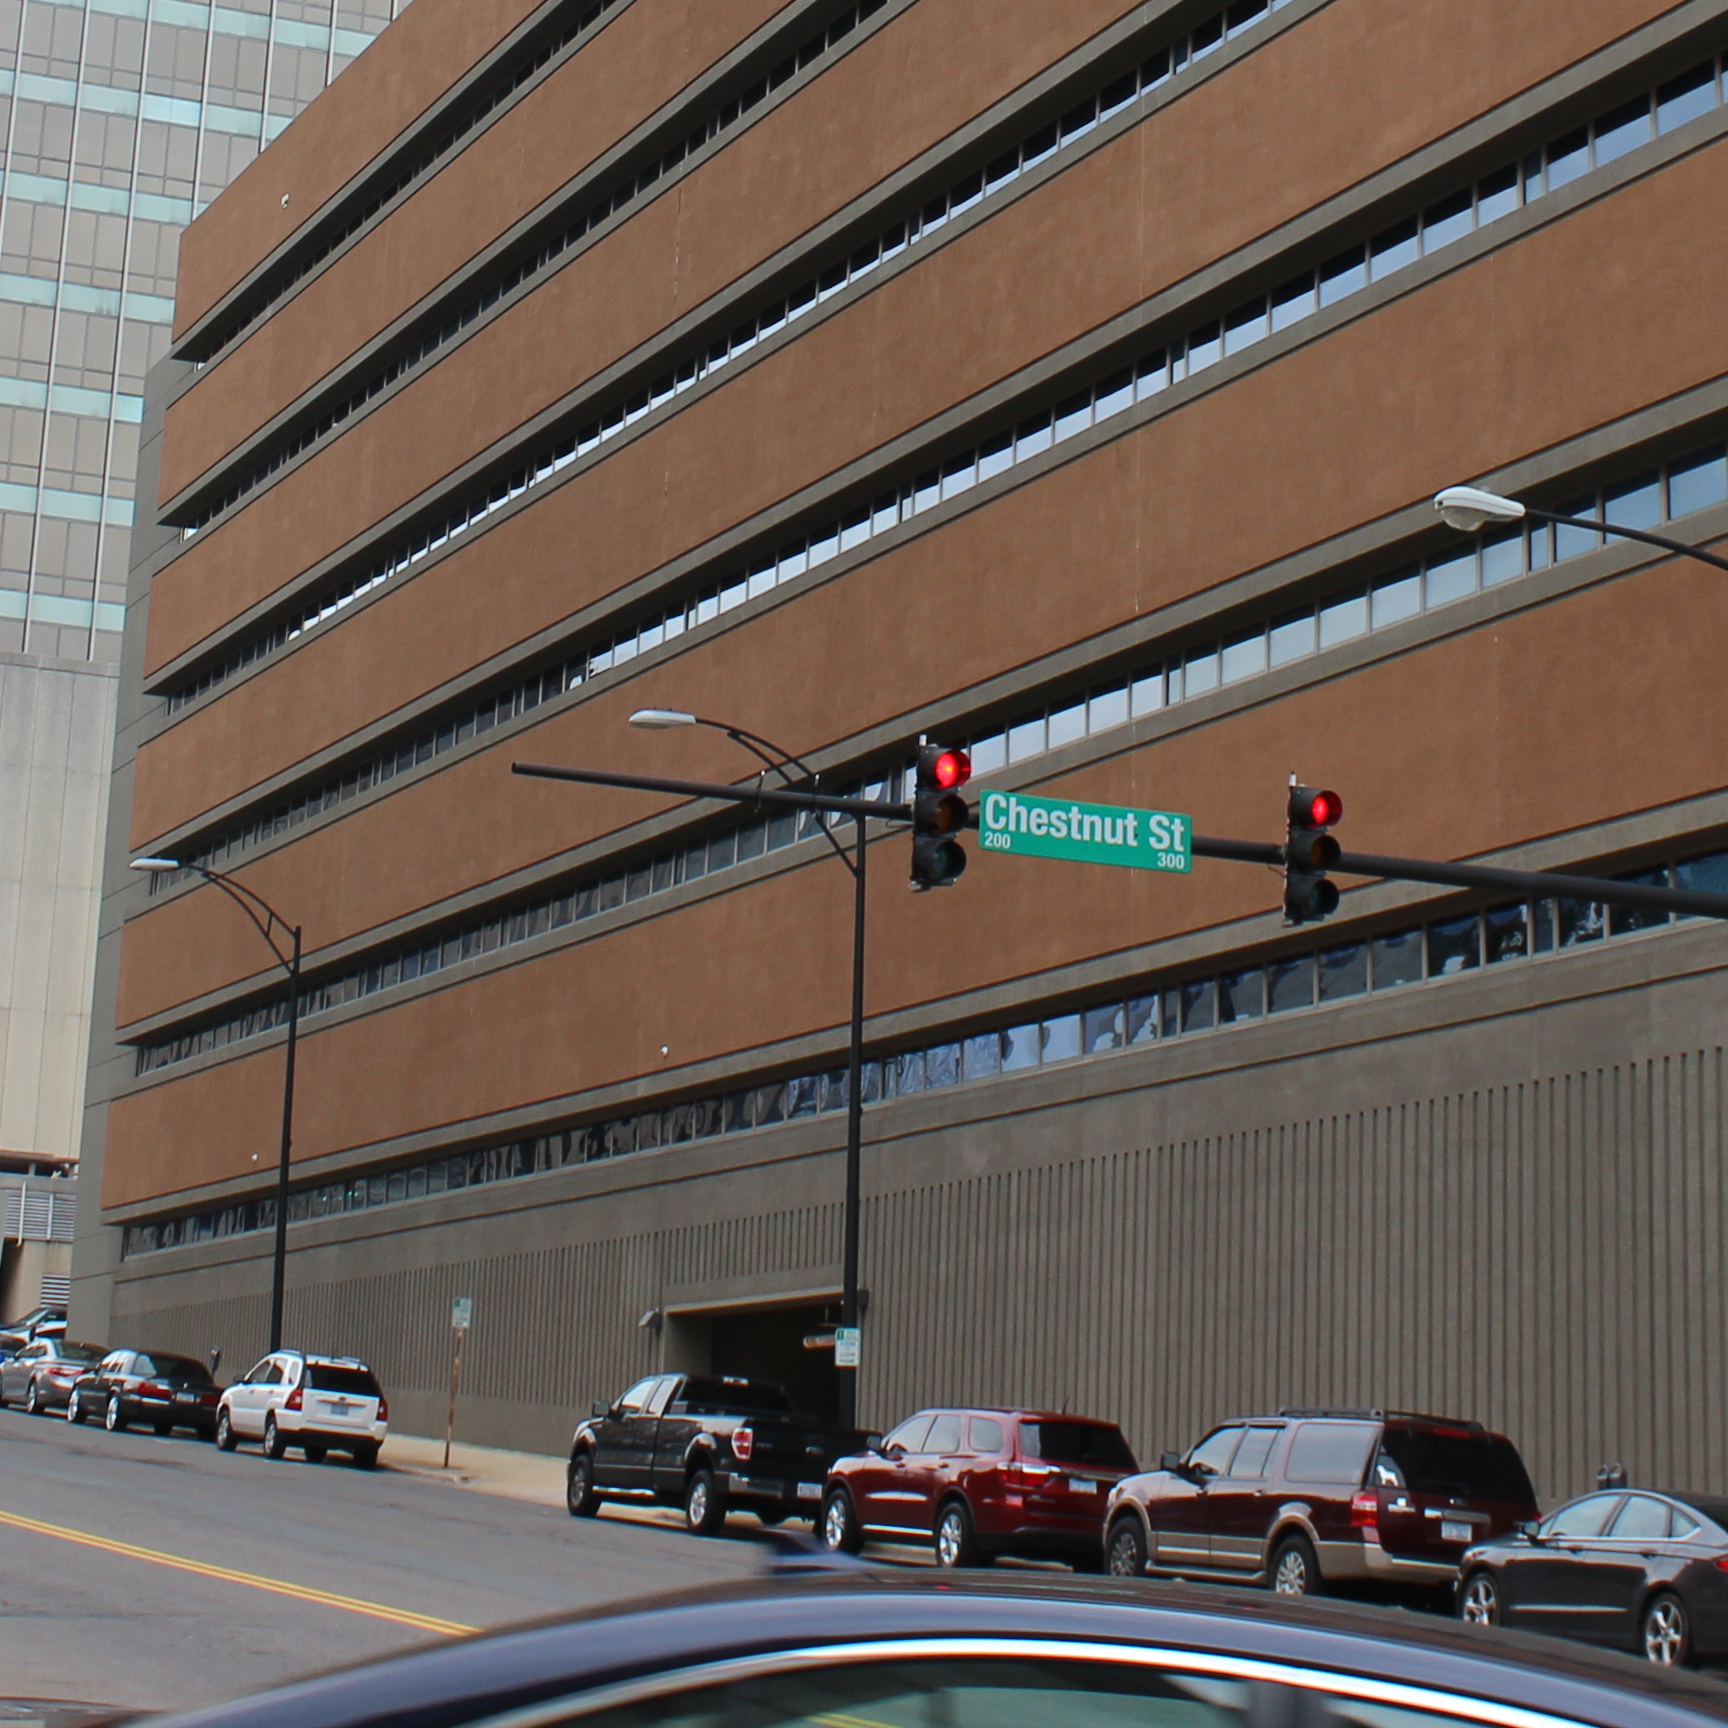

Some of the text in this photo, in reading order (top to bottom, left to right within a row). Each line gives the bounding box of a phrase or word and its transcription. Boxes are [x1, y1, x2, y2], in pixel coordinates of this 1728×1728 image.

[984, 792, 1186, 853] Chestnut St
[984, 832, 1012, 850] 200
[1157, 852, 1186, 870] 300
